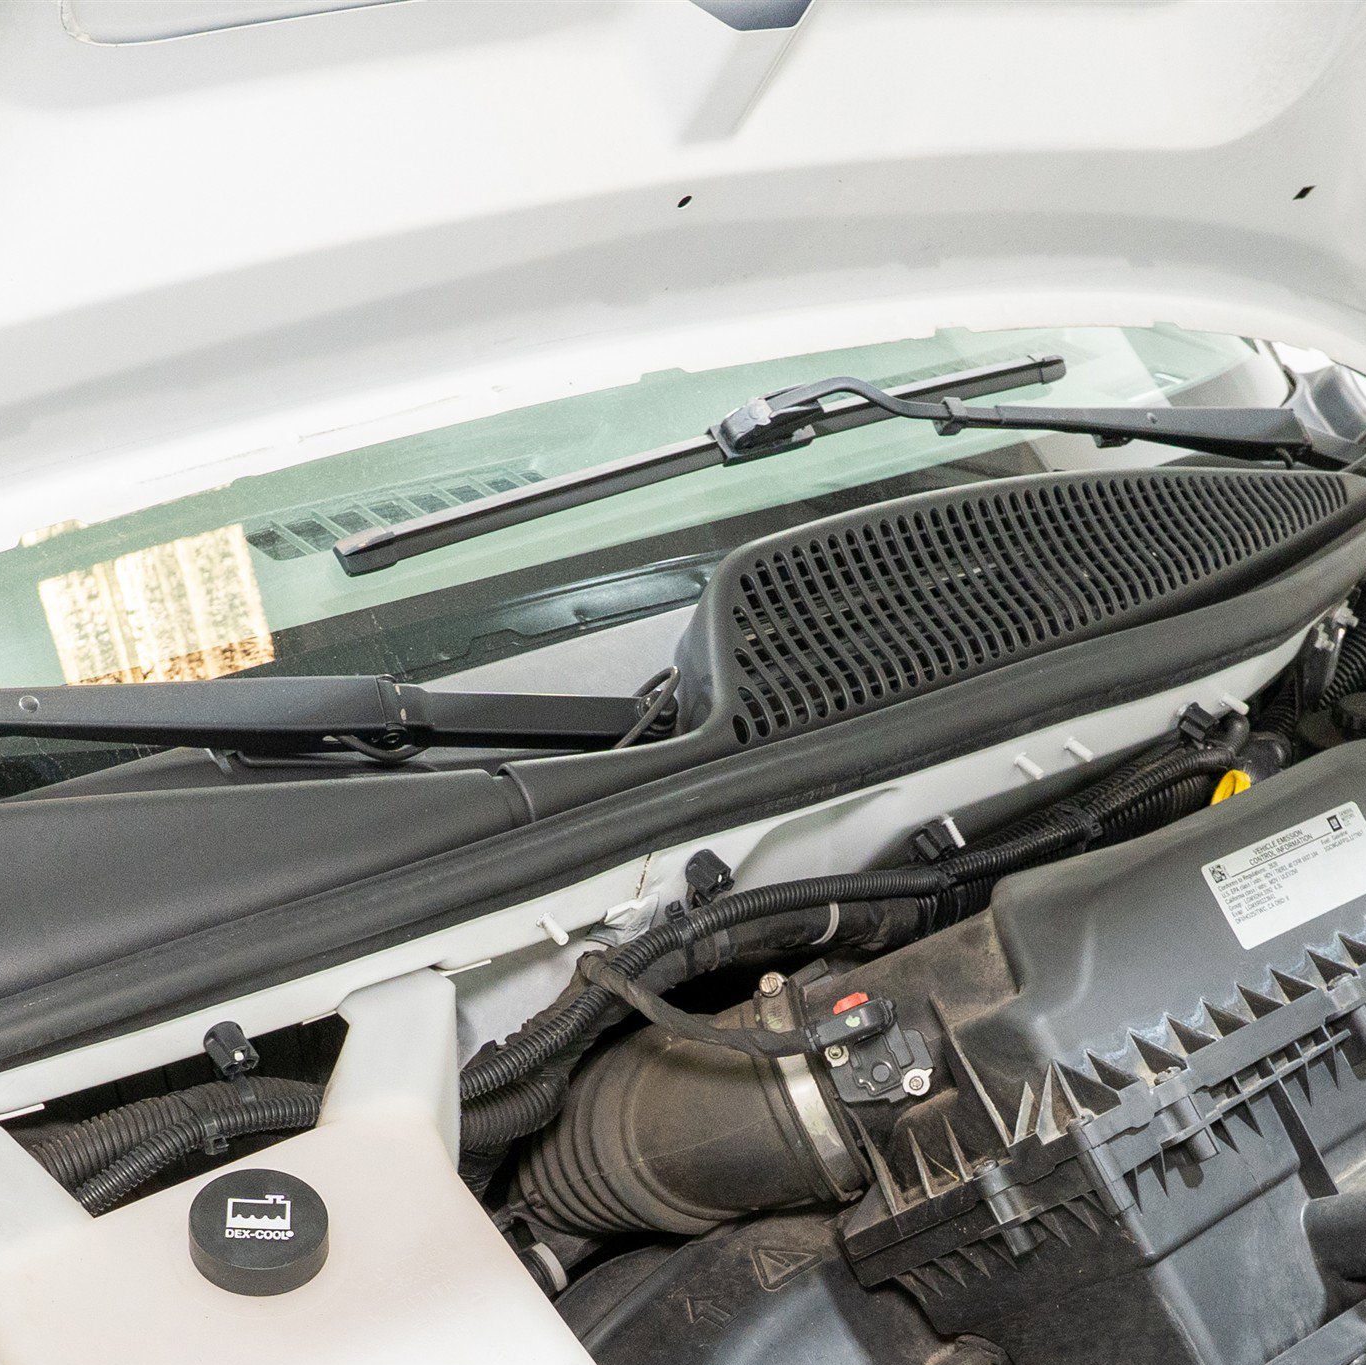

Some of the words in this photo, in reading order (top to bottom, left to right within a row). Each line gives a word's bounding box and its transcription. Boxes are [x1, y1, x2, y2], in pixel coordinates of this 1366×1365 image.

[1249, 851, 1275, 865] CONTROL
[1276, 834, 1313, 853] INFORMATION
[1253, 841, 1276, 855] VEHICLE
[1276, 830, 1303, 845] EMISSION
